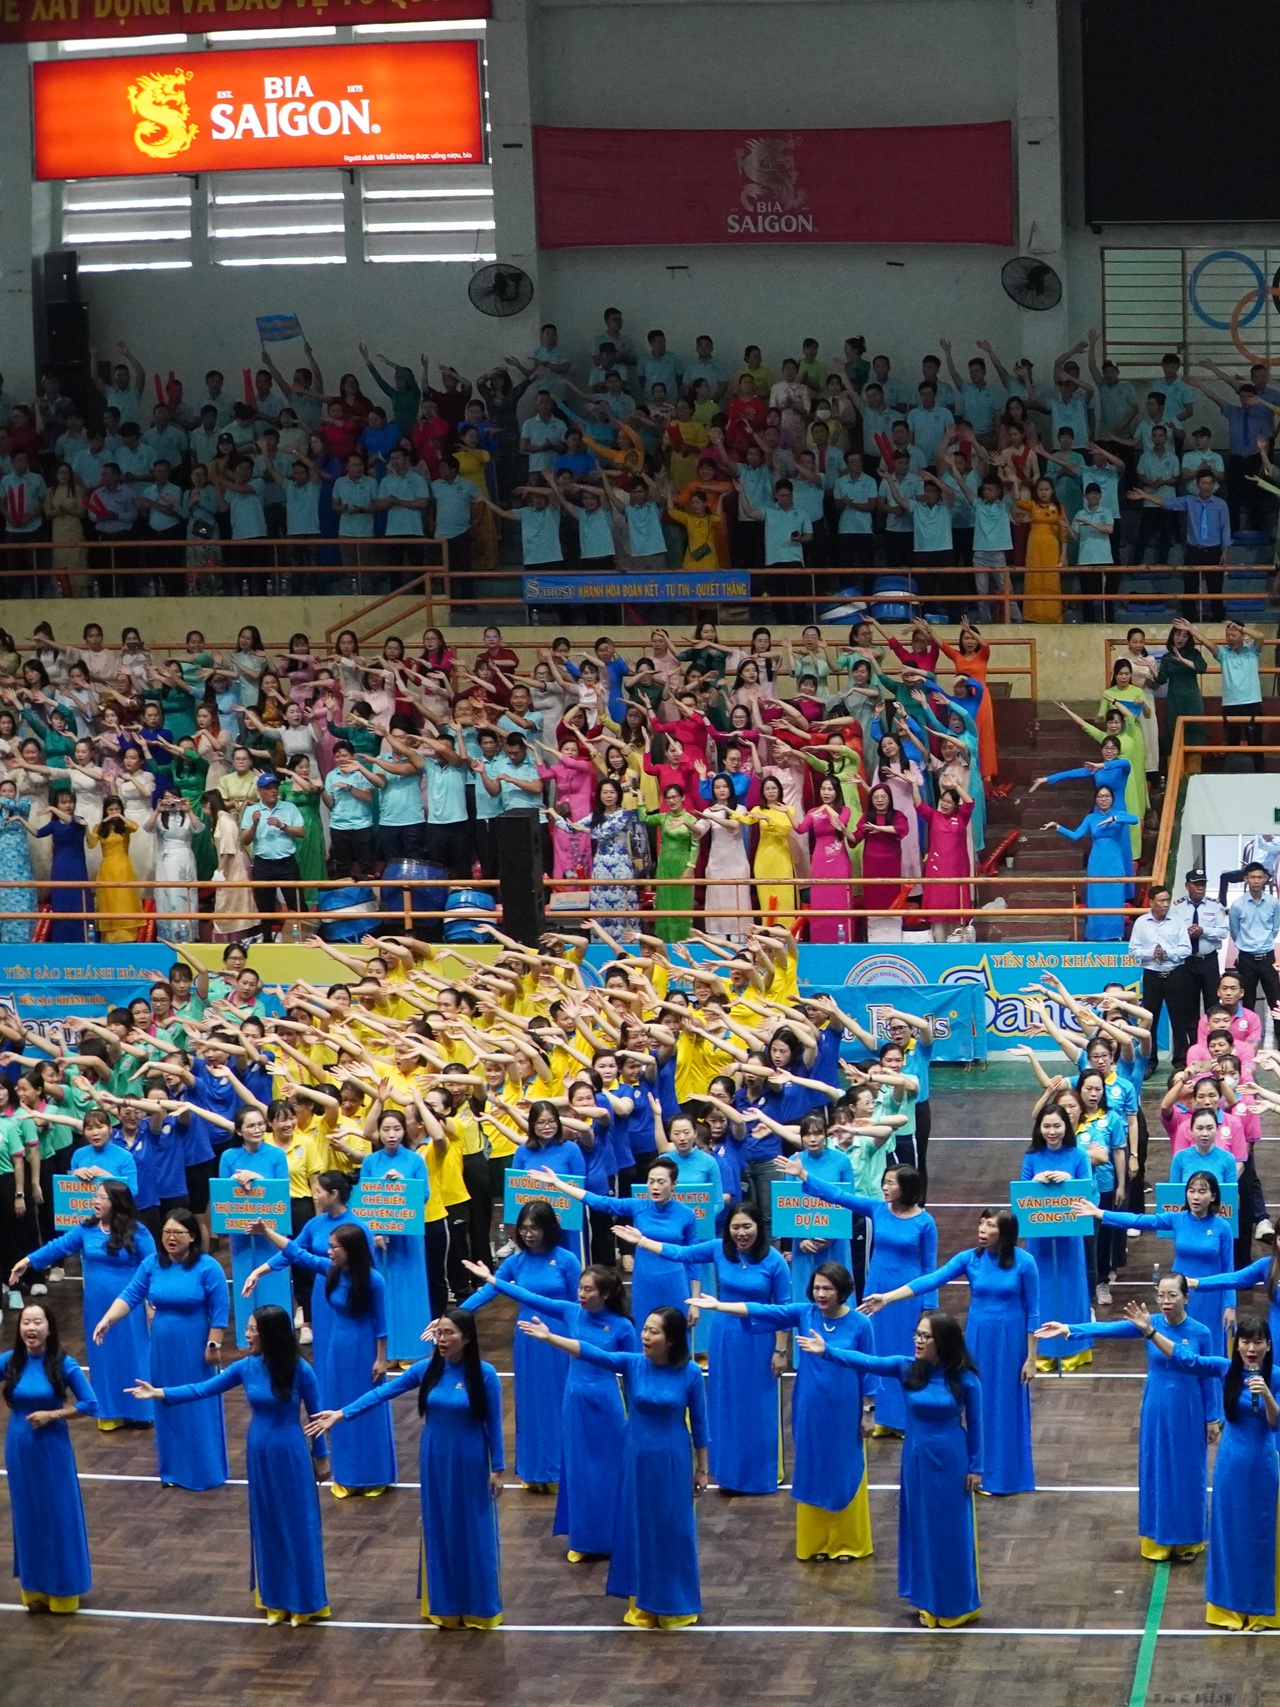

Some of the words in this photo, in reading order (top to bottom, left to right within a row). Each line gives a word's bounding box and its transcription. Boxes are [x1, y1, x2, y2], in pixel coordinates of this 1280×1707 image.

[264, 76, 314, 99] BIA
[757, 202, 783, 213] BIA
[727, 214, 813, 233] SAIGON
[578, 582, 603, 597] KHÁNH
[606, 581, 620, 597] HÒA
[677, 583, 690, 596] TIN
[991, 951, 1024, 968] YẾN
[1027, 952, 1058, 967] SÀO
[1061, 952, 1118, 968] KHÁNH
[3, 964, 31, 980] YẾN
[34, 965, 62, 979] SÀO
[64, 965, 114, 979] KHÁNH
[117, 965, 149, 979] HÒA
[59, 1181, 97, 1192] TRUNG
[361, 1181, 383, 1191] NHÀ
[362, 1192, 383, 1205] CHẾ
[383, 1194, 406, 1205] BIẾN
[778, 1197, 800, 1208] BAN
[256, 1203, 271, 1214] CAO
[352, 1207, 393, 1218] NGUYÊN
[394, 1208, 416, 1221] LIỆU
[1219, 1202, 1232, 1218] ÀI
[225, 1218, 252, 1229] SANES
[795, 1213, 812, 1229] DỰ
[813, 1212, 830, 1226] ÁN
[1029, 1211, 1062, 1223] CÔNG
[367, 1219, 383, 1231] ẾN
[385, 1220, 405, 1231] SÀO
